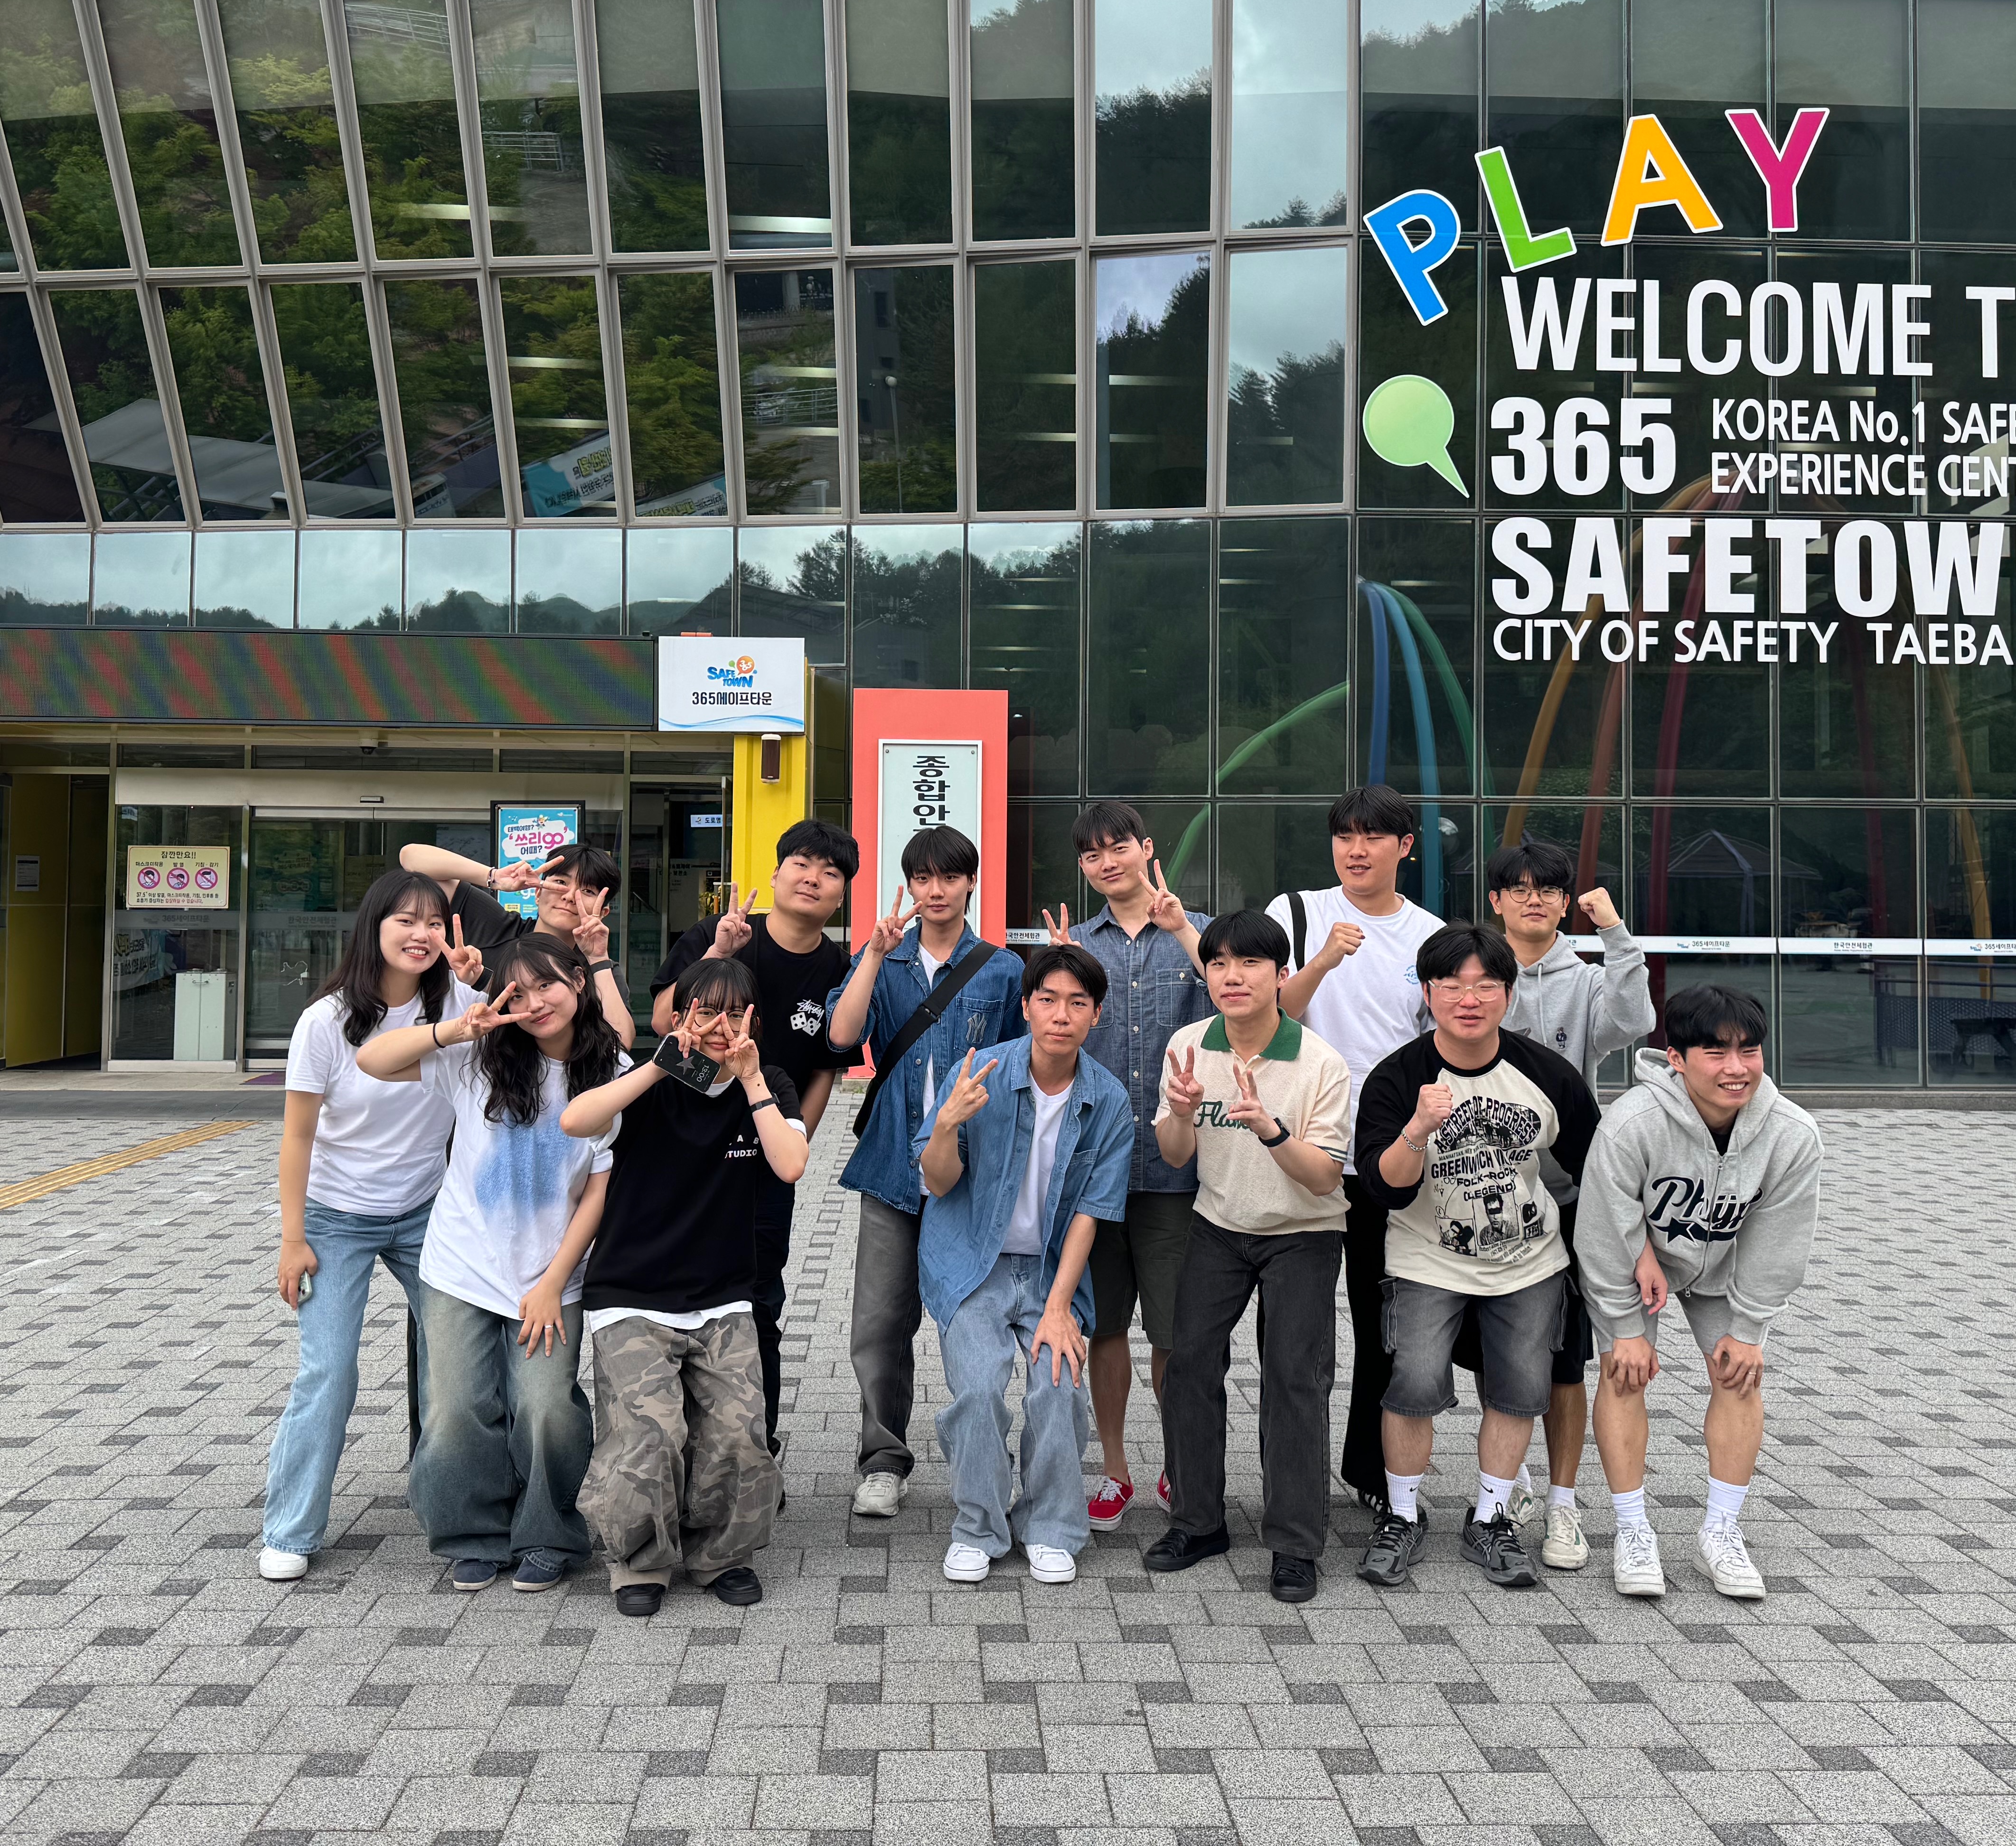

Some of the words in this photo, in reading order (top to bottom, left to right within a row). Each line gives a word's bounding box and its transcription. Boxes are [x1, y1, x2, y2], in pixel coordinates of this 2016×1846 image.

[1363, 108, 1830, 326] PLAY
[1501, 276, 1933, 376] WELCOME
[1713, 398, 1840, 442] KOREA
[1850, 401, 1925, 446] No.1
[1491, 397, 1676, 496] 365
[1712, 452, 1926, 496] EXPERIENCE
[1491, 517, 2005, 618] SAFETOW
[1493, 618, 1592, 661] CITY
[1601, 619, 1659, 662] OF
[1674, 619, 1838, 663] SAFETY
[1866, 623, 2014, 665] TAEBA
[707, 666, 735, 680] SAFE
[722, 675, 754, 688] TOWN
[692, 692, 772, 705] 365세이프타운
[912, 756, 951, 832] 종합안
[521, 845, 543, 855] 어때?
[1440, 1099, 1474, 1145] STREET
[1472, 1096, 1483, 1117] OF
[1486, 1097, 1538, 1145] PROGRESS
[1431, 1150, 1494, 1179] GREENWICH
